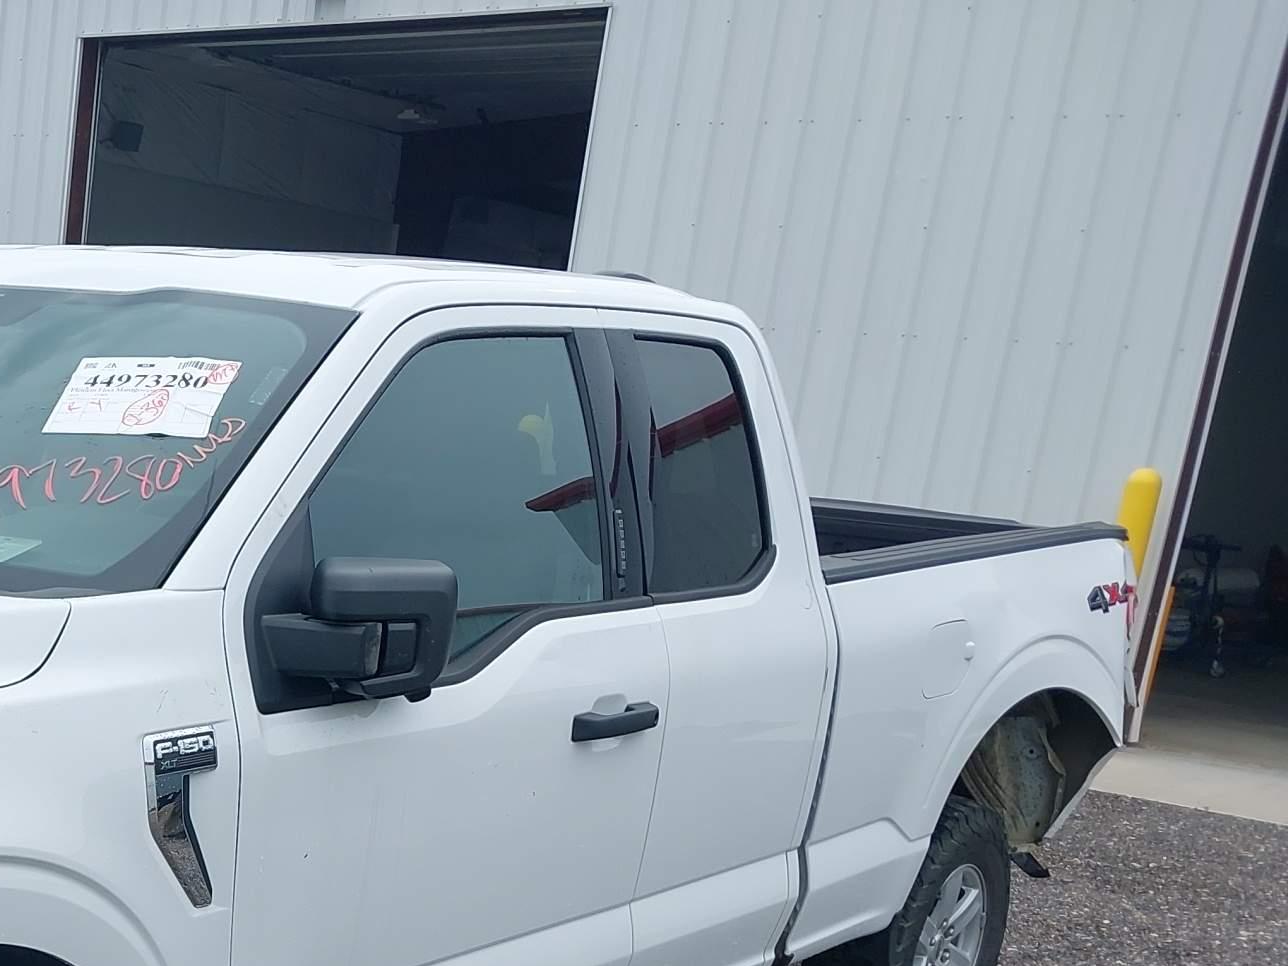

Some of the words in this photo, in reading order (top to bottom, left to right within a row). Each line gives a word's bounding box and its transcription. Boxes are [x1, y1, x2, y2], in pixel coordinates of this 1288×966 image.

[84, 372, 208, 388] 44973280
[156, 735, 214, 759] F-150
[161, 758, 178, 770] XLT
